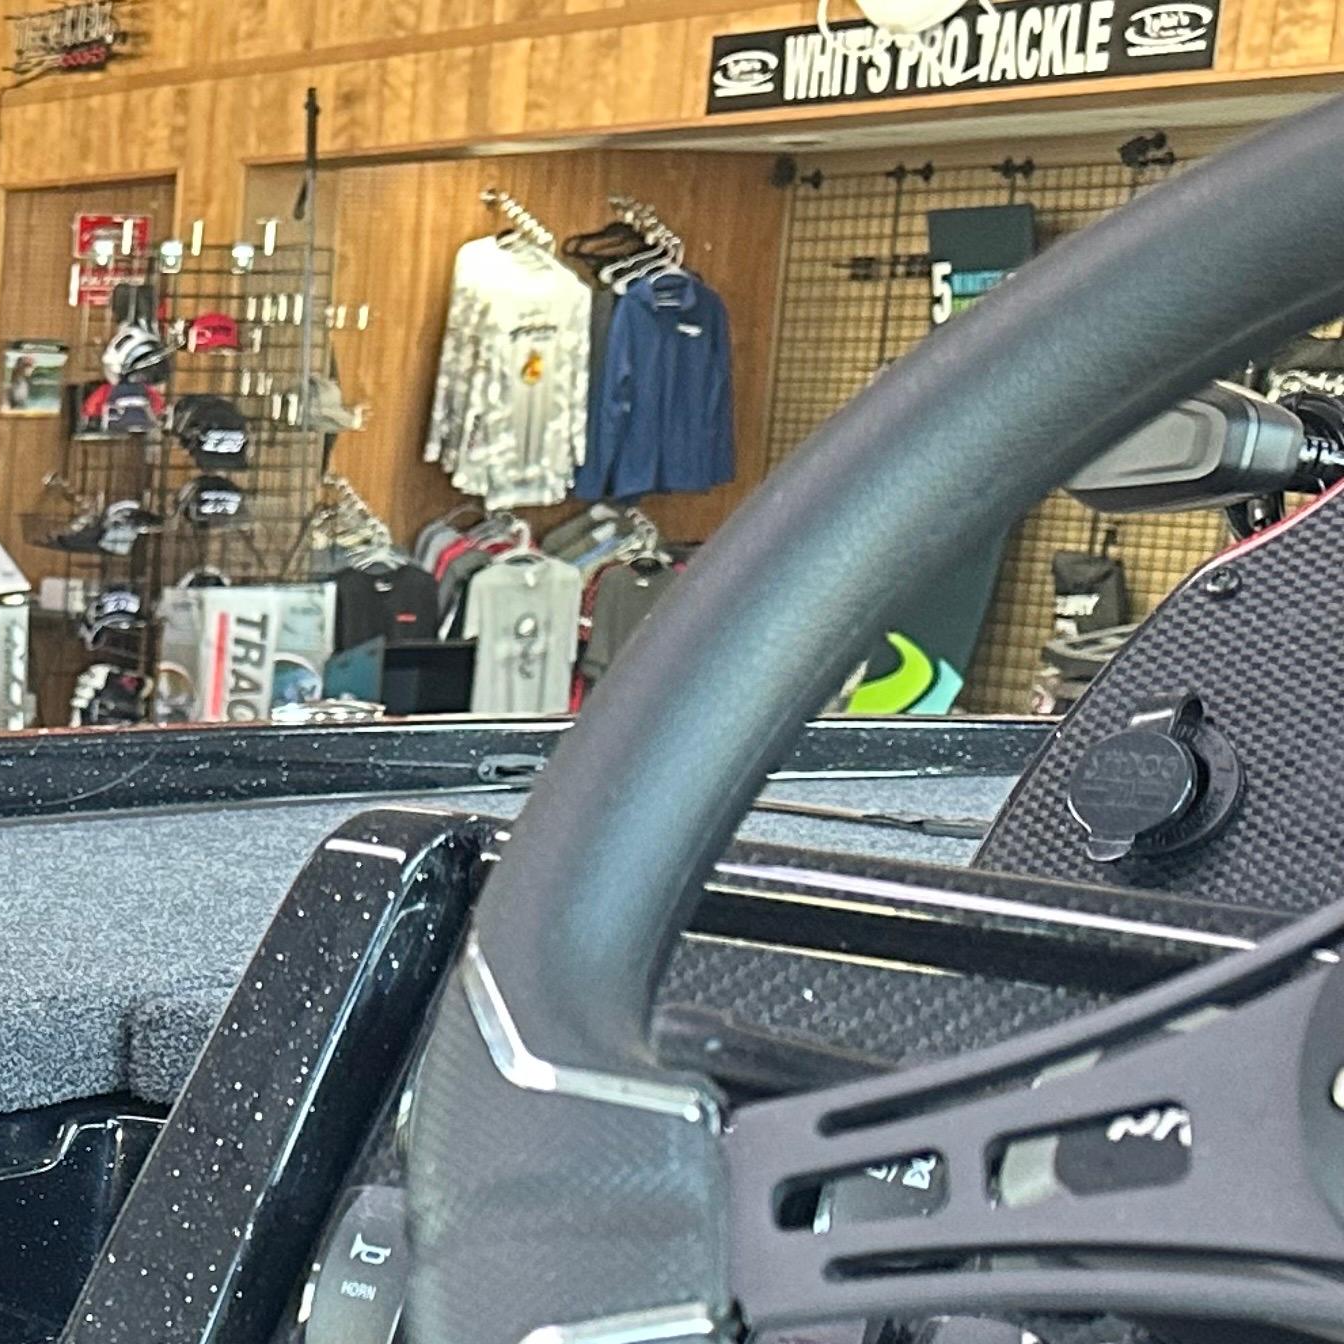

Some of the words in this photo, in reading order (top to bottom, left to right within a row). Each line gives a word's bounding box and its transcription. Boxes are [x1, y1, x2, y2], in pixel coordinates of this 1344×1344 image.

[894, 16, 971, 91] PRO
[975, 0, 1114, 83] TACKLE
[931, 261, 952, 324] 5
[340, 1279, 377, 1302] HORN
